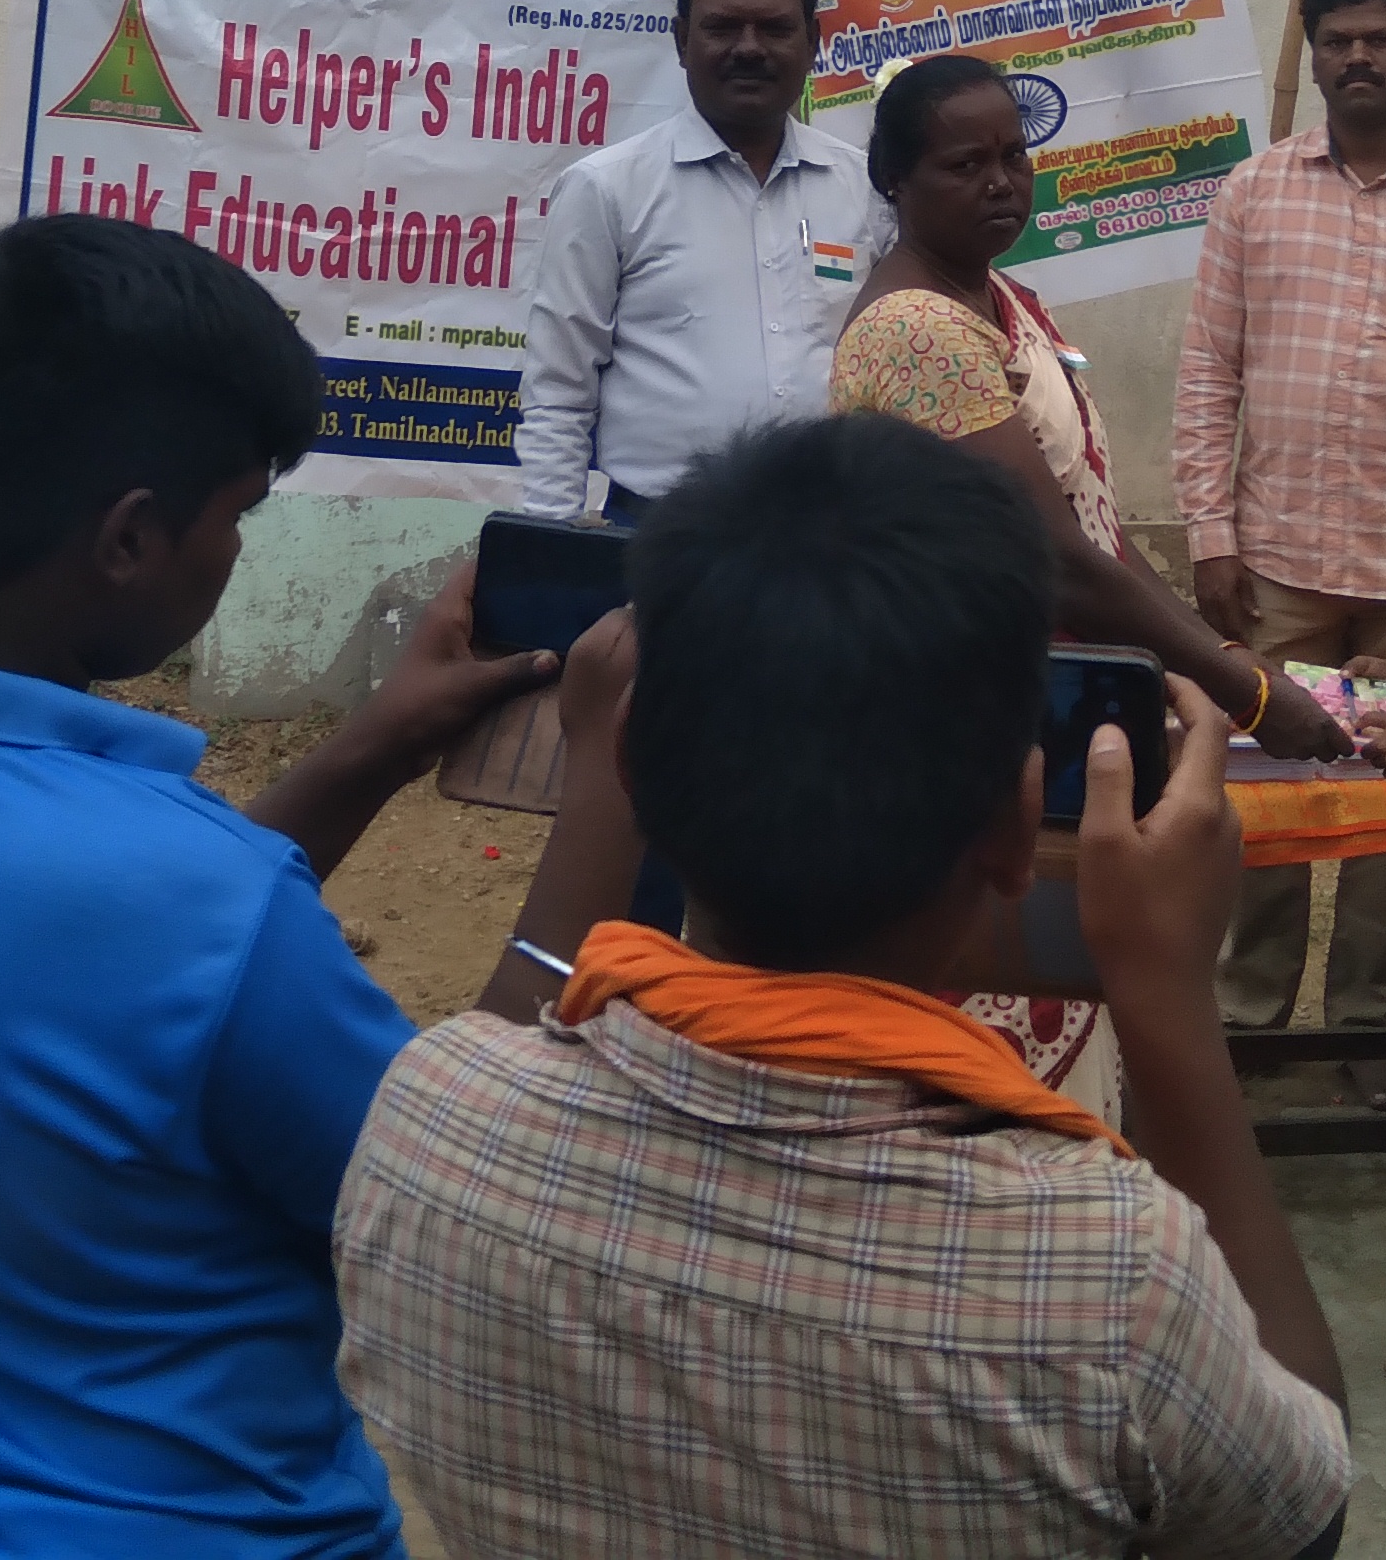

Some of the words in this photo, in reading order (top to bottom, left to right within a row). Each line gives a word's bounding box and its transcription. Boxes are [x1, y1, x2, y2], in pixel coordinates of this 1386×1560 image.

[832, 8, 952, 77] அப்துல்கலாம்
[217, 22, 451, 151] Helper's
[471, 43, 609, 146] India
[1092, 192, 1156, 216] 89400
[1098, 210, 1163, 236] 86100
[1169, 200, 1215, 222] 122
[184, 170, 518, 289] Educational
[345, 315, 359, 336] E
[379, 320, 423, 341] mail
[321, 374, 373, 404] reet,
[378, 375, 521, 416] Nallamanaya
[351, 412, 512, 448] Tamilnadu,Ind
